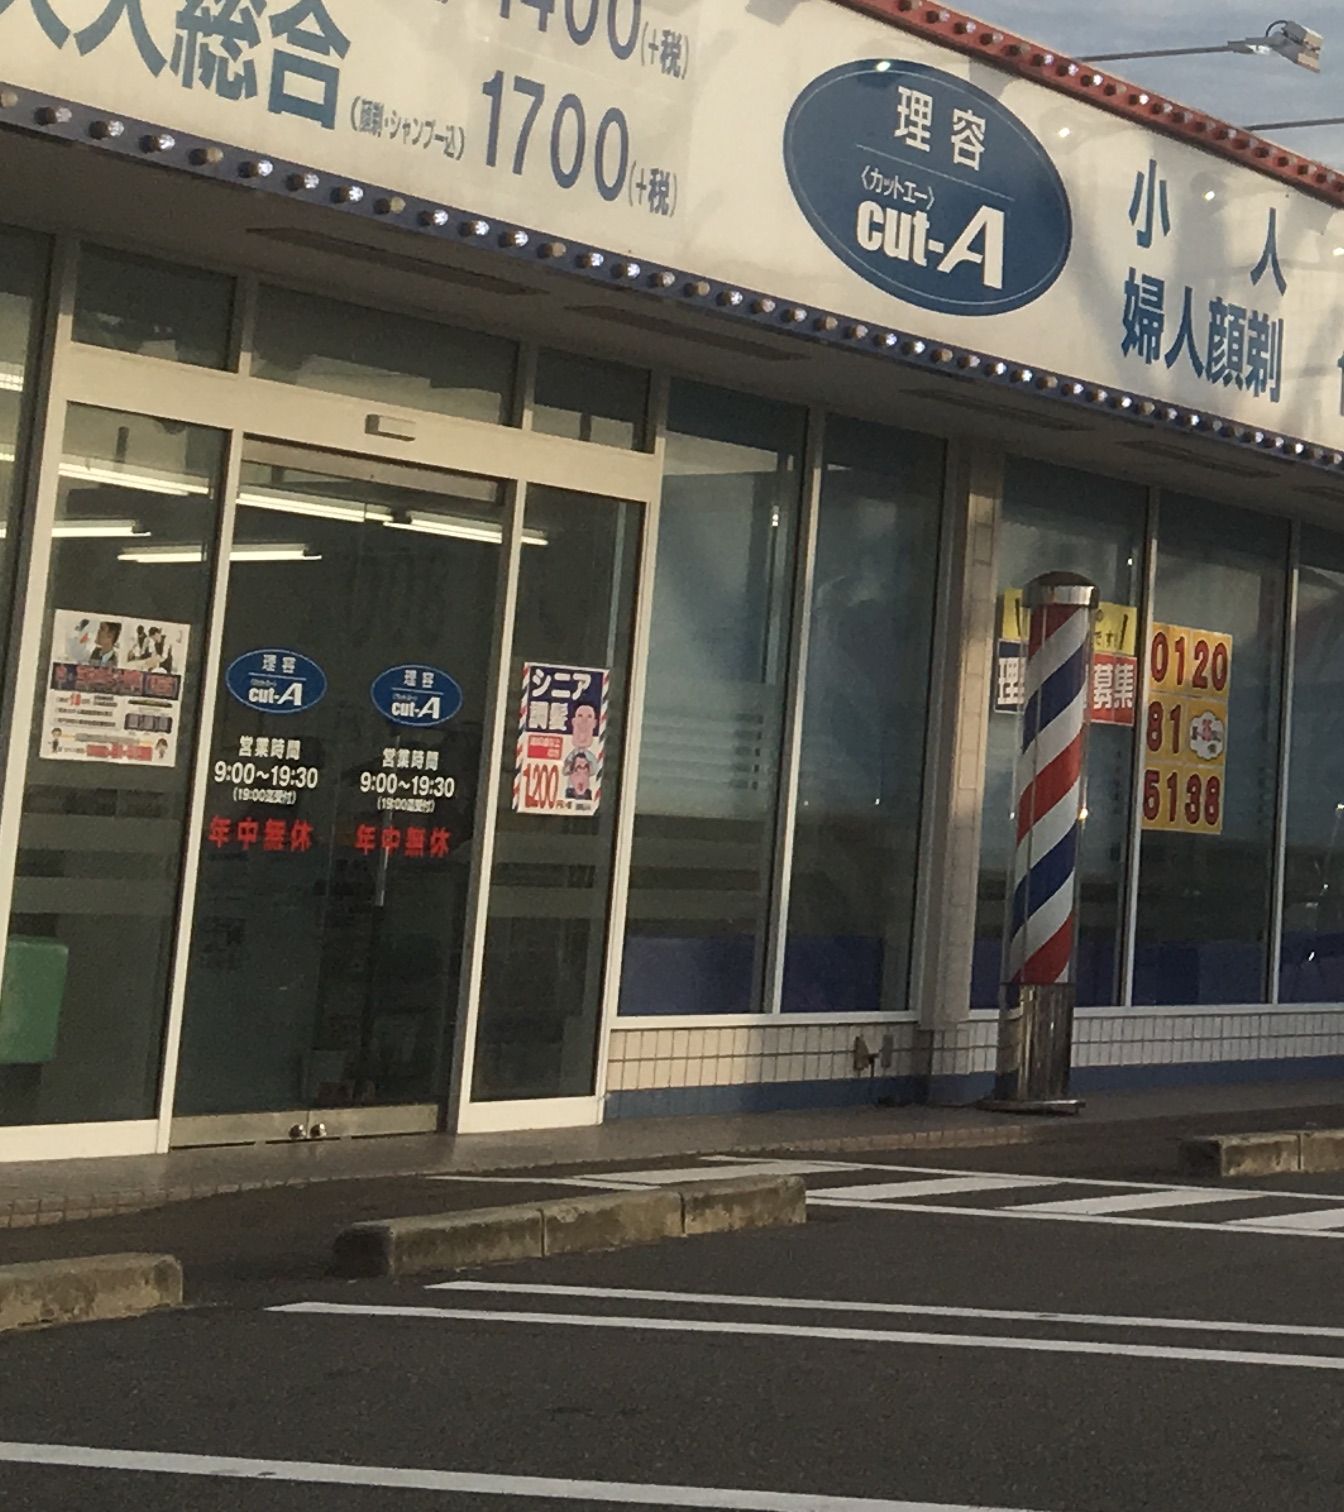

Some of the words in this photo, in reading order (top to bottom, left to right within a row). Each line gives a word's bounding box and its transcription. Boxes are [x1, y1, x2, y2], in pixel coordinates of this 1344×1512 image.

[482, 70, 629, 201] 1700
[894, 86, 987, 172] 理容
[856, 199, 1006, 290] cut-A
[1121, 268, 1283, 404] 婦人顔剃
[531, 667, 593, 702] シニア
[1151, 631, 1229, 692] 0120
[1146, 700, 1182, 754] 81
